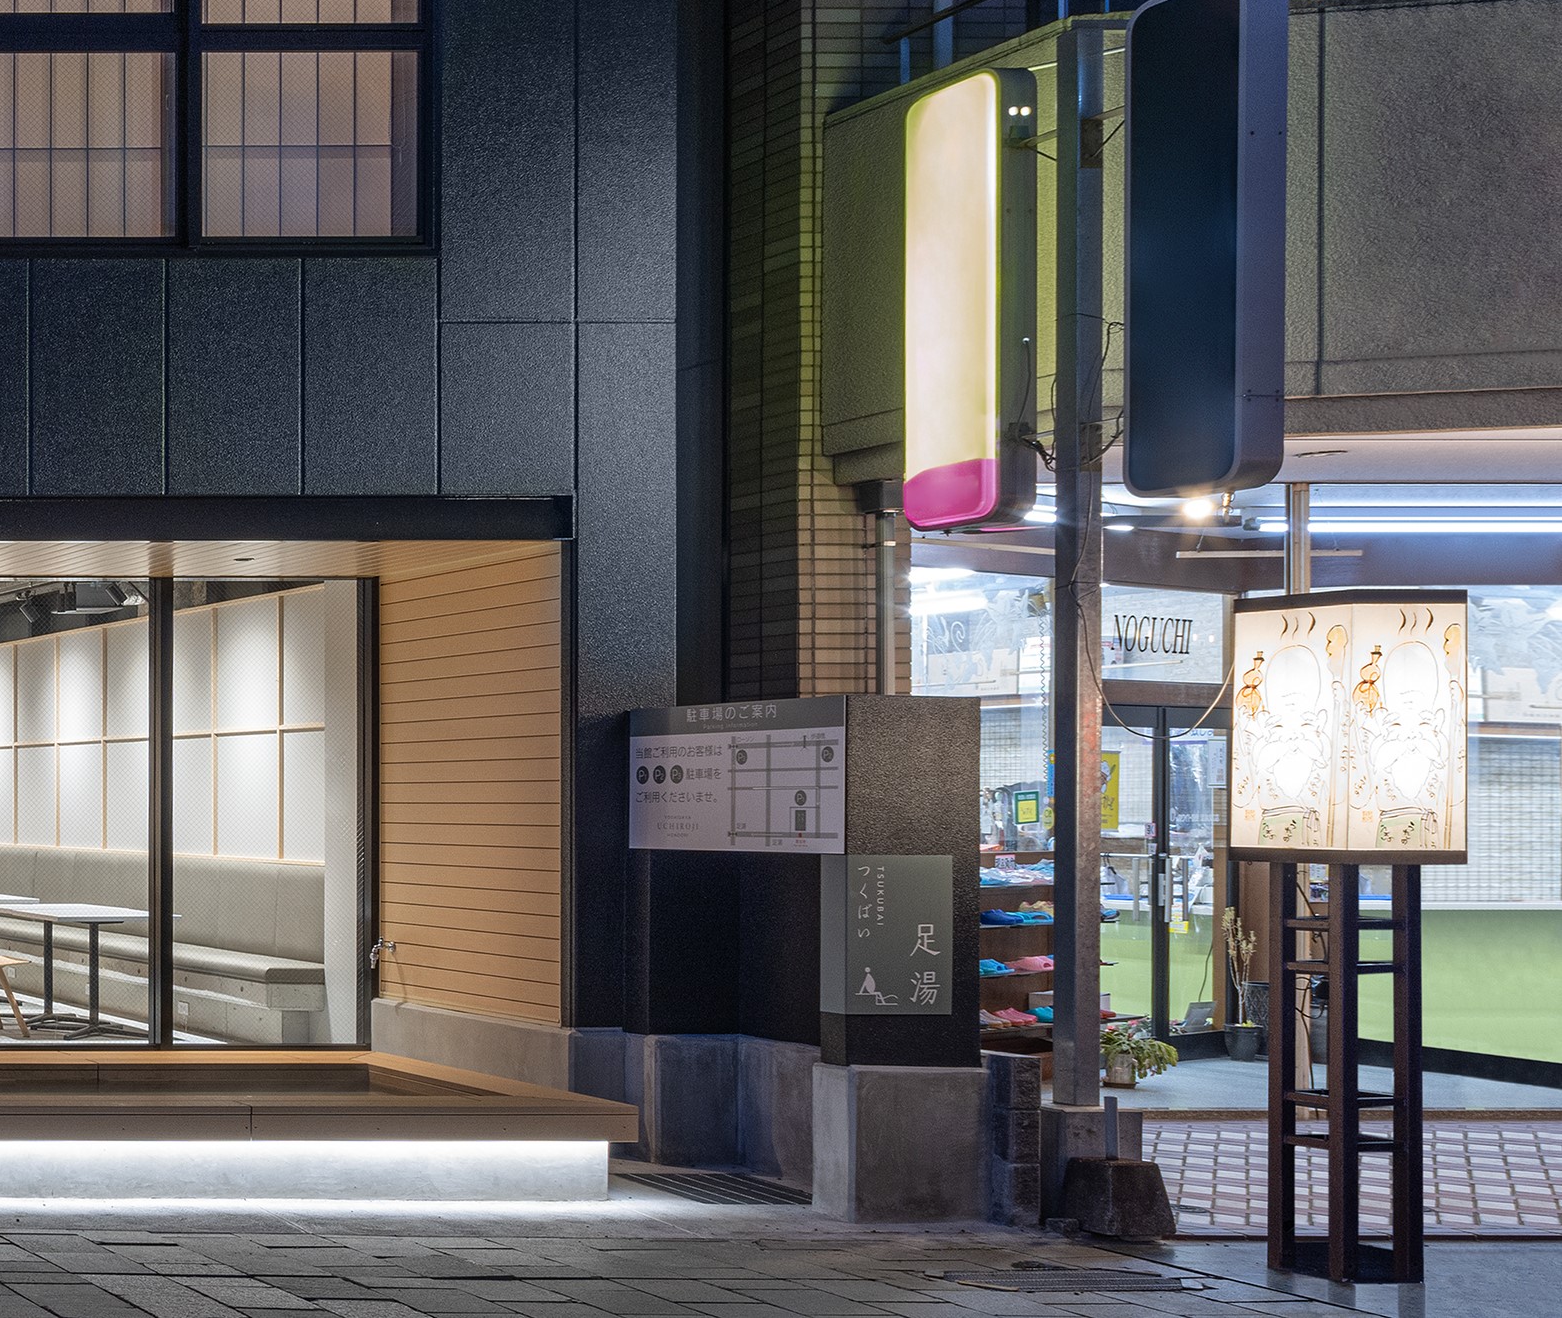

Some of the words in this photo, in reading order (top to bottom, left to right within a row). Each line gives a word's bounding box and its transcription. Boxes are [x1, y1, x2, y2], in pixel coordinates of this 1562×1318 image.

[1114, 614, 1194, 655] NOGUCHI
[686, 704, 777, 723] 駐車場のご案内
[635, 745, 723, 759] 当館ご利用のお客様は
[685, 767, 722, 780] 駐車場を
[635, 791, 718, 803] ご利用くださいませ。
[656, 822, 699, 832] UCHIROJI
[857, 865, 873, 938] つくばい
[876, 865, 885, 926] TSUKUBAI
[910, 923, 941, 1006] 足湯
